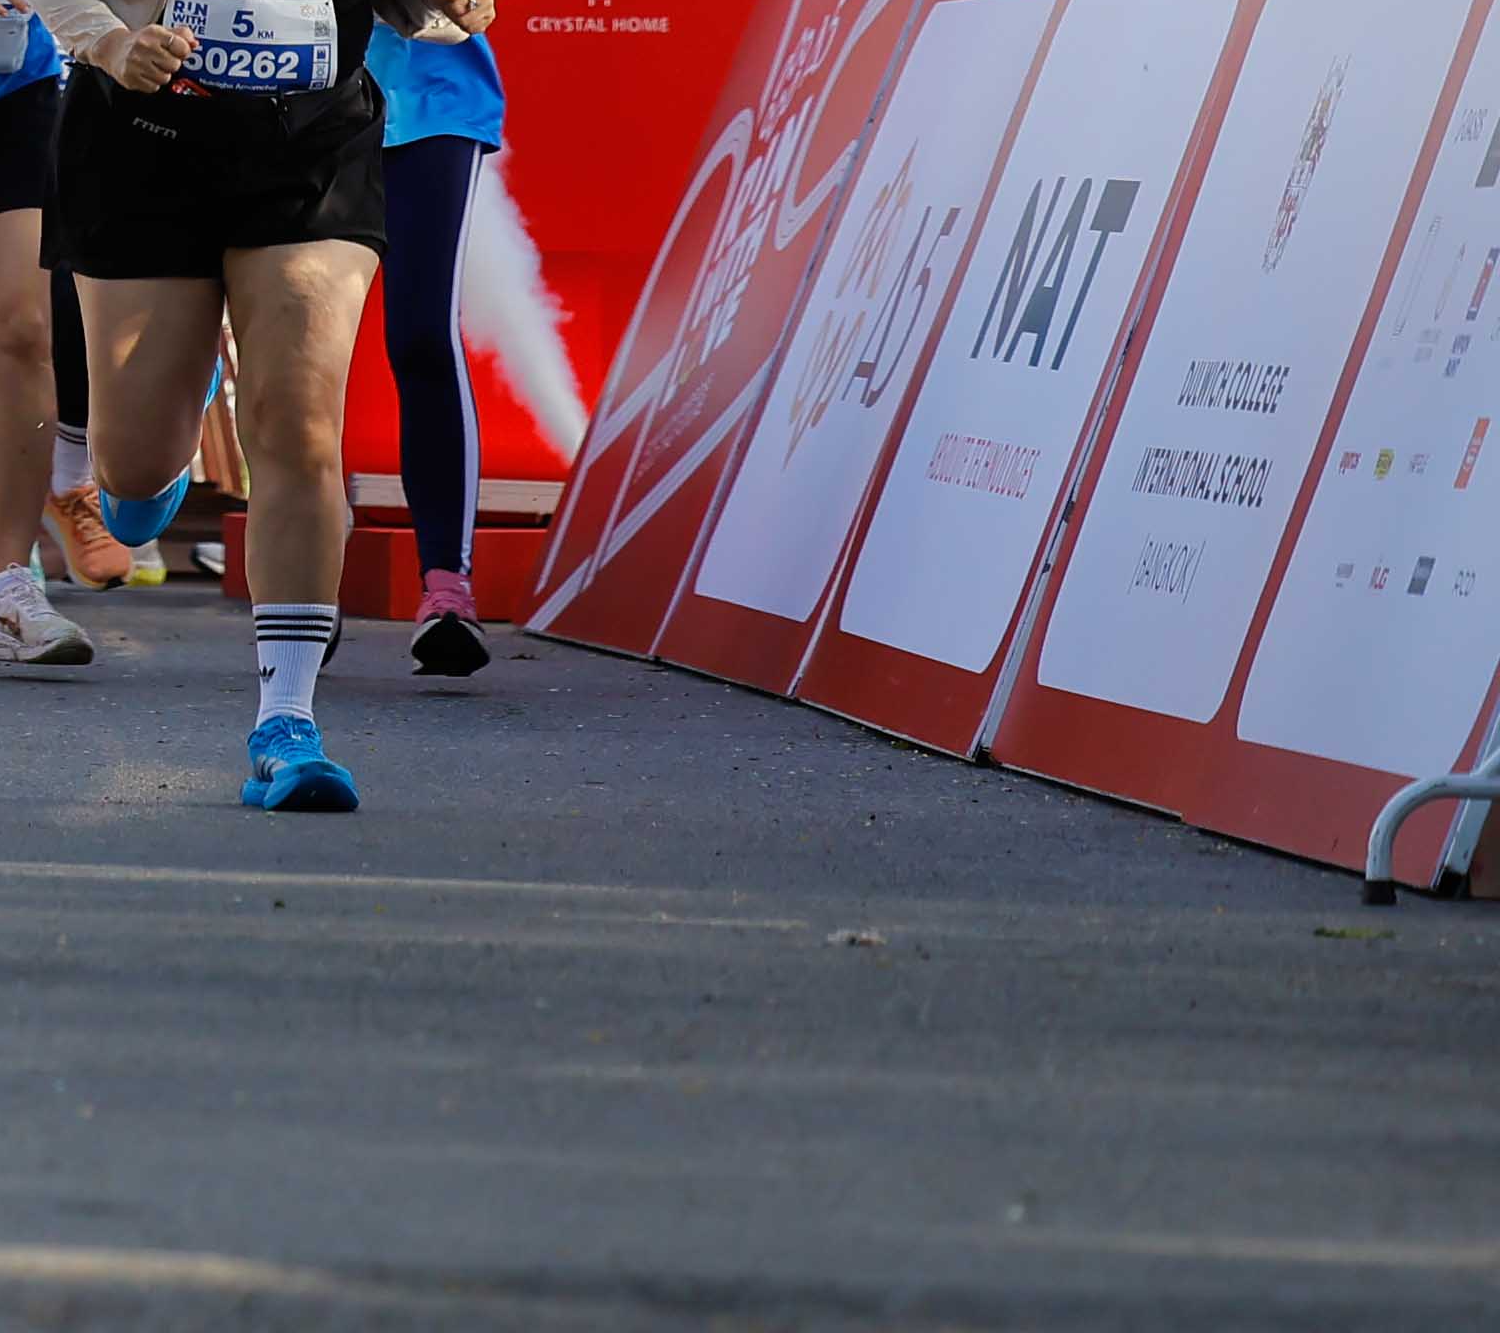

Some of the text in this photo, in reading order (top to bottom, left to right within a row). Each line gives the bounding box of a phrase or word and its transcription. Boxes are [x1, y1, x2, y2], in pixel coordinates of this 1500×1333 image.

[172, 13, 207, 25] WITH
[173, 0, 208, 16] RUN
[231, 10, 274, 39] 5 KM
[527, 17, 669, 33] CRYSTAL HOME
[969, 177, 1141, 371] NAT
[842, 206, 961, 408] A5
[1177, 361, 1290, 413] DULWICH COLLEGE
[1132, 447, 1273, 508] INTERNATIONAL SCHOOL
